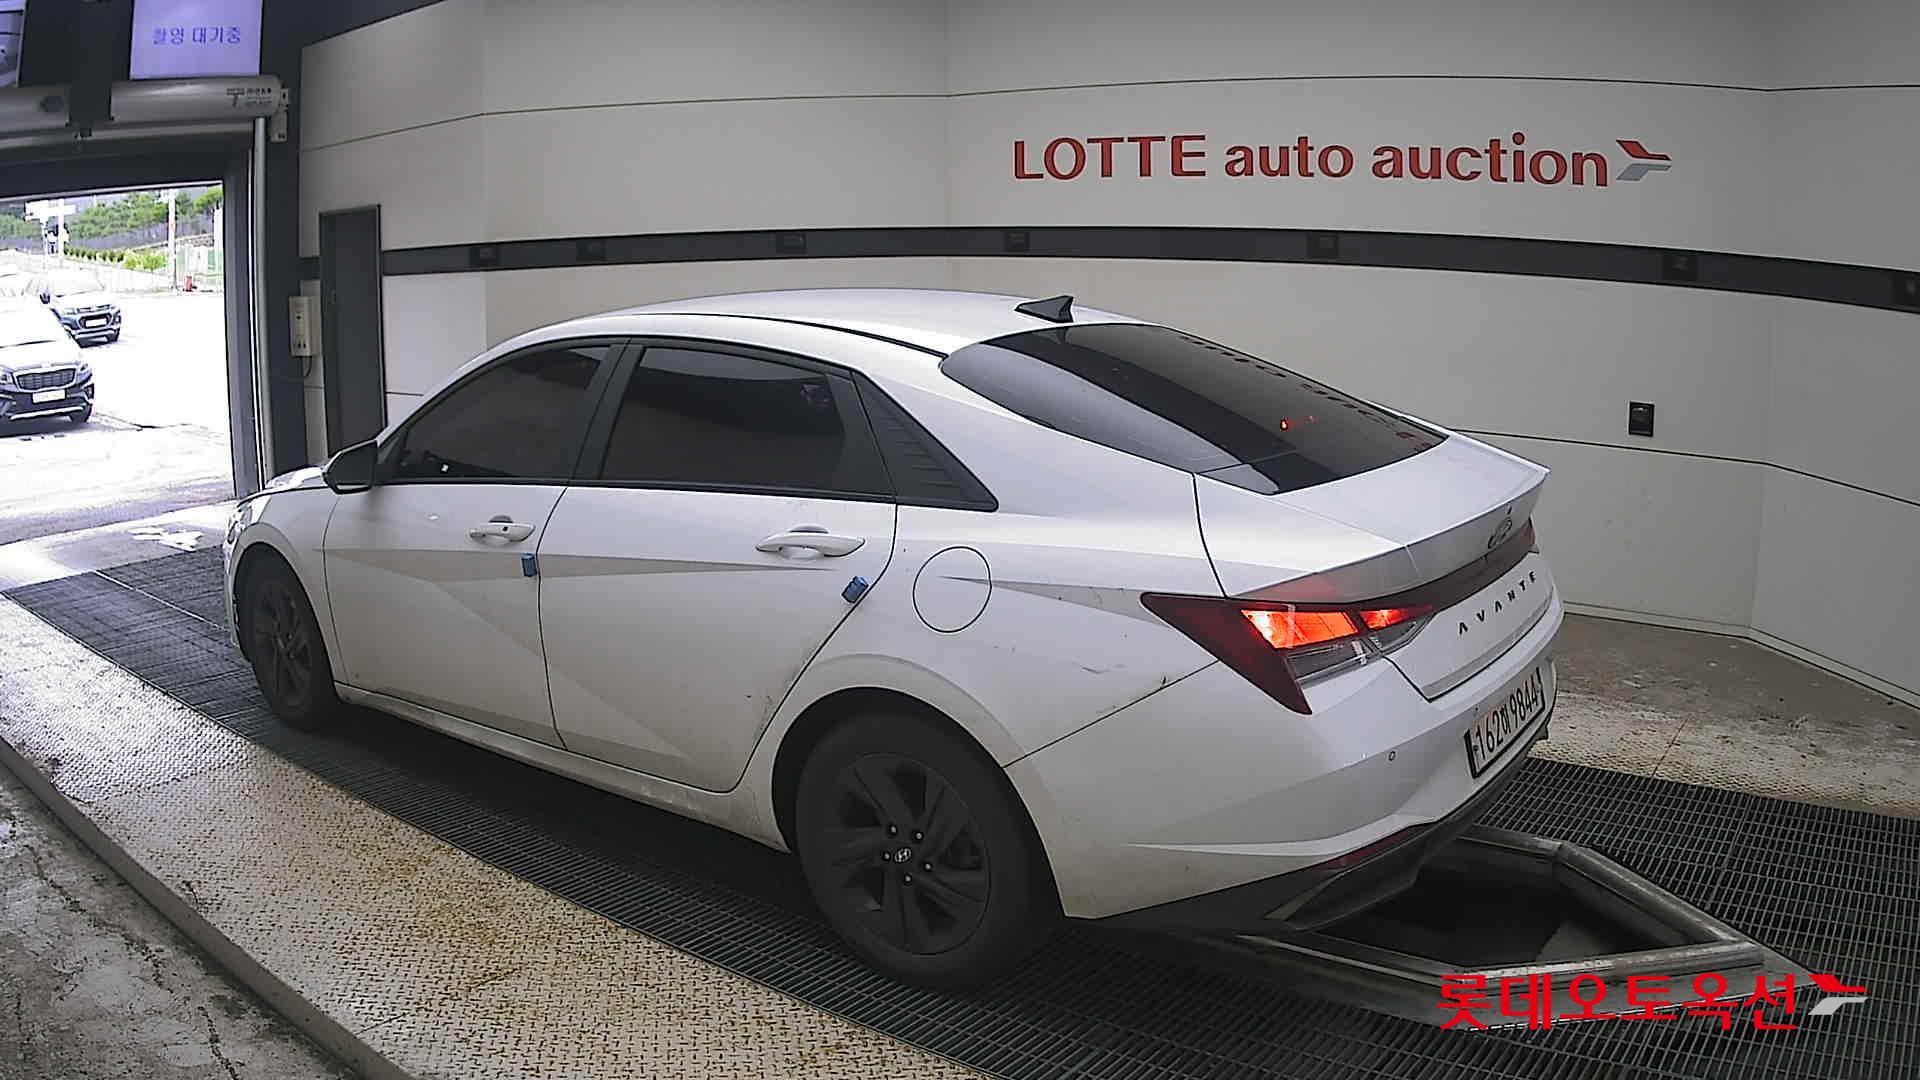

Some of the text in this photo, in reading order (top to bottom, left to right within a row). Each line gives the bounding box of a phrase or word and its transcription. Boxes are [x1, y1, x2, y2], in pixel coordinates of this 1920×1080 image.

[192, 26, 241, 44] 대기중
[1014, 132, 1608, 187] LOTTE auto auction
[1458, 571, 1536, 635] AVANTE
